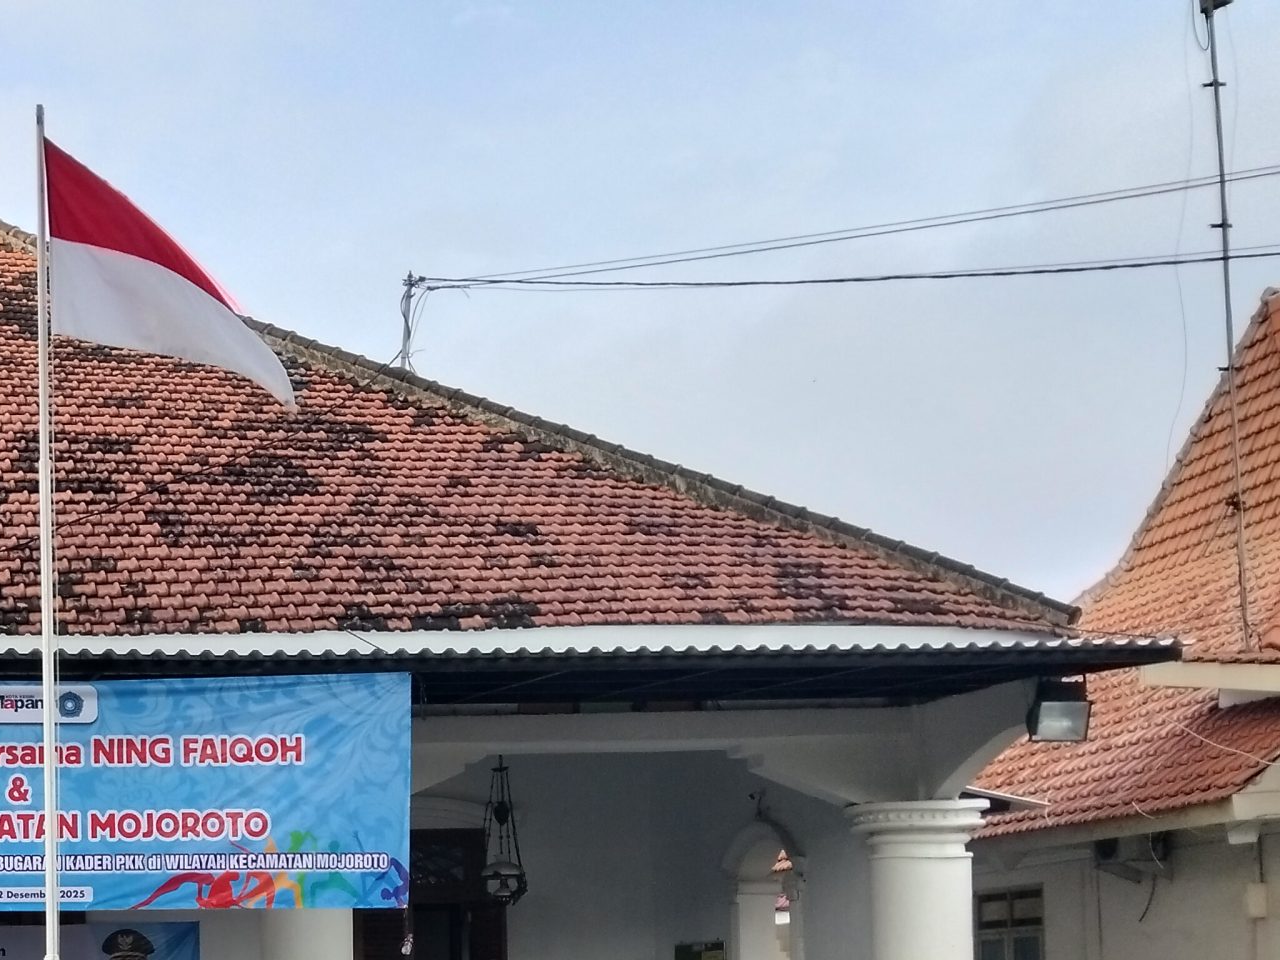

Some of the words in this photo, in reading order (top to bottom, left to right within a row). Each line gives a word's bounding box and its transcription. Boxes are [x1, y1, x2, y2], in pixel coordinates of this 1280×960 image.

[93, 737, 171, 764] NING
[183, 737, 302, 763] FAIQOH
[8, 777, 29, 802] &
[91, 811, 269, 839] MOJOROTO
[66, 855, 112, 870] KADER
[116, 855, 143, 870] PKK
[148, 854, 161, 870] di
[165, 854, 226, 870] WILAYAH
[230, 853, 313, 869] KECAMATAN
[317, 853, 388, 869] MOJOROTO
[6, 890, 46, 899] Desemb
[60, 890, 85, 899] 2025
